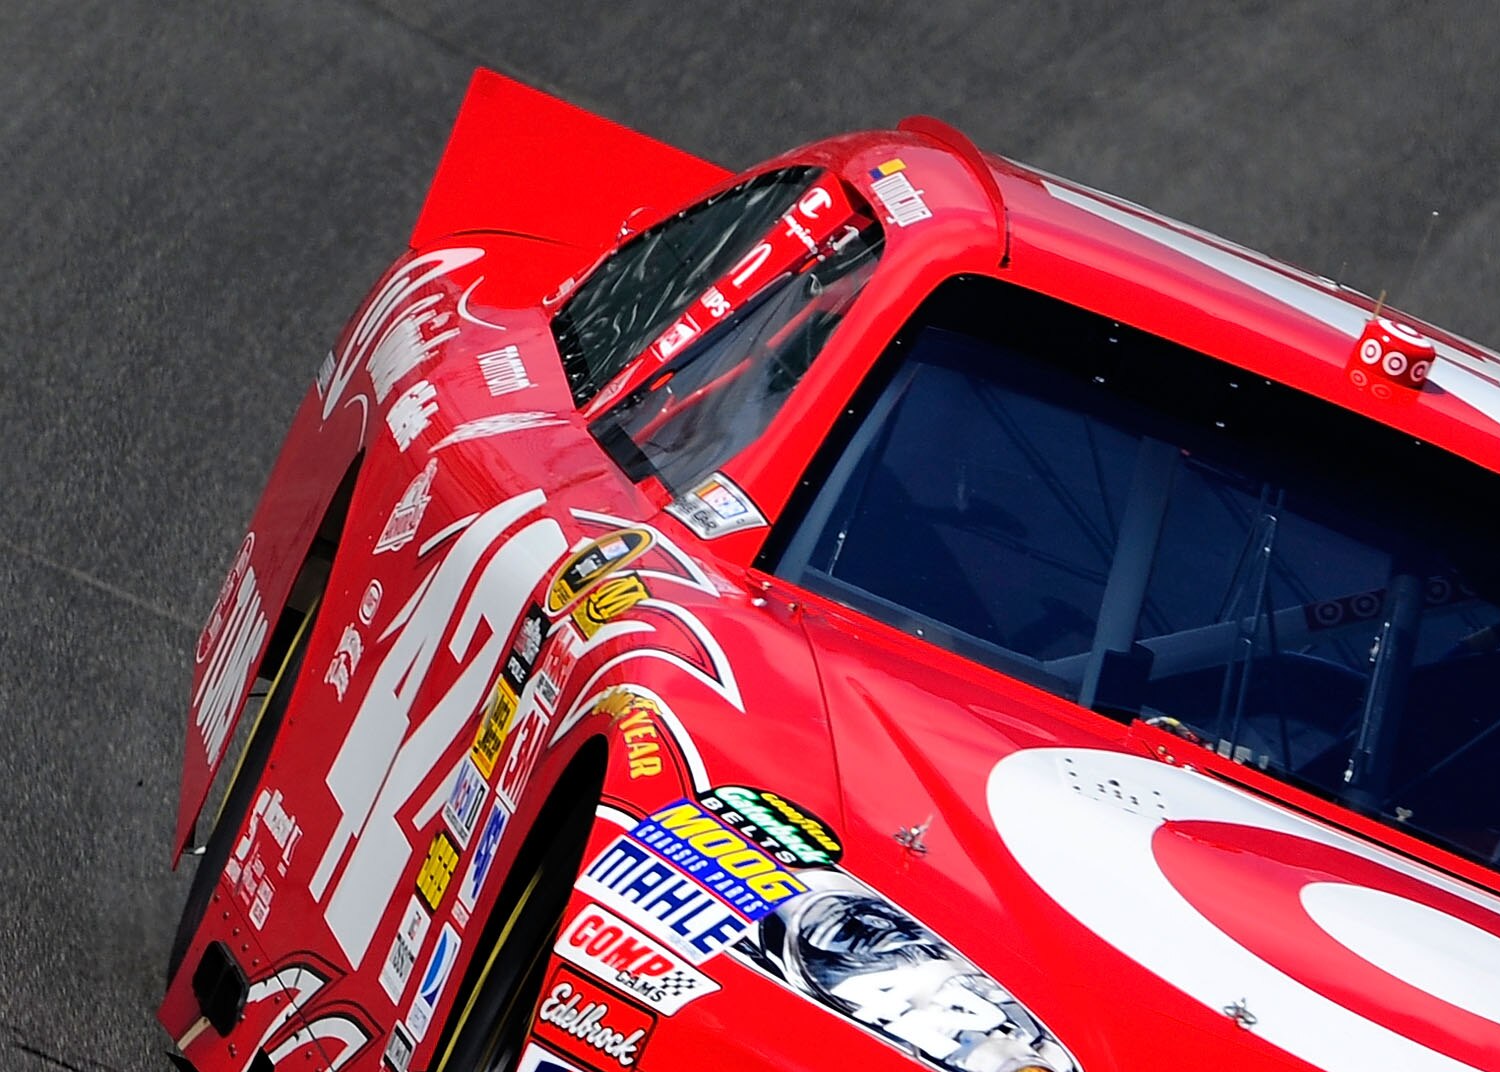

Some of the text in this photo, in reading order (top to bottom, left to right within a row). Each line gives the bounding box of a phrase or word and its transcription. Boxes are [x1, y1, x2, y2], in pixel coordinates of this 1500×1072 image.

[636, 824, 767, 913] CHASSIS PARTS
[650, 803, 808, 903] MOOG
[700, 797, 797, 865] BELTS
[587, 838, 747, 955] MAHLE
[568, 913, 676, 979] COMP
[615, 969, 668, 1003] CAMS
[539, 982, 646, 1067] Edelbrock
